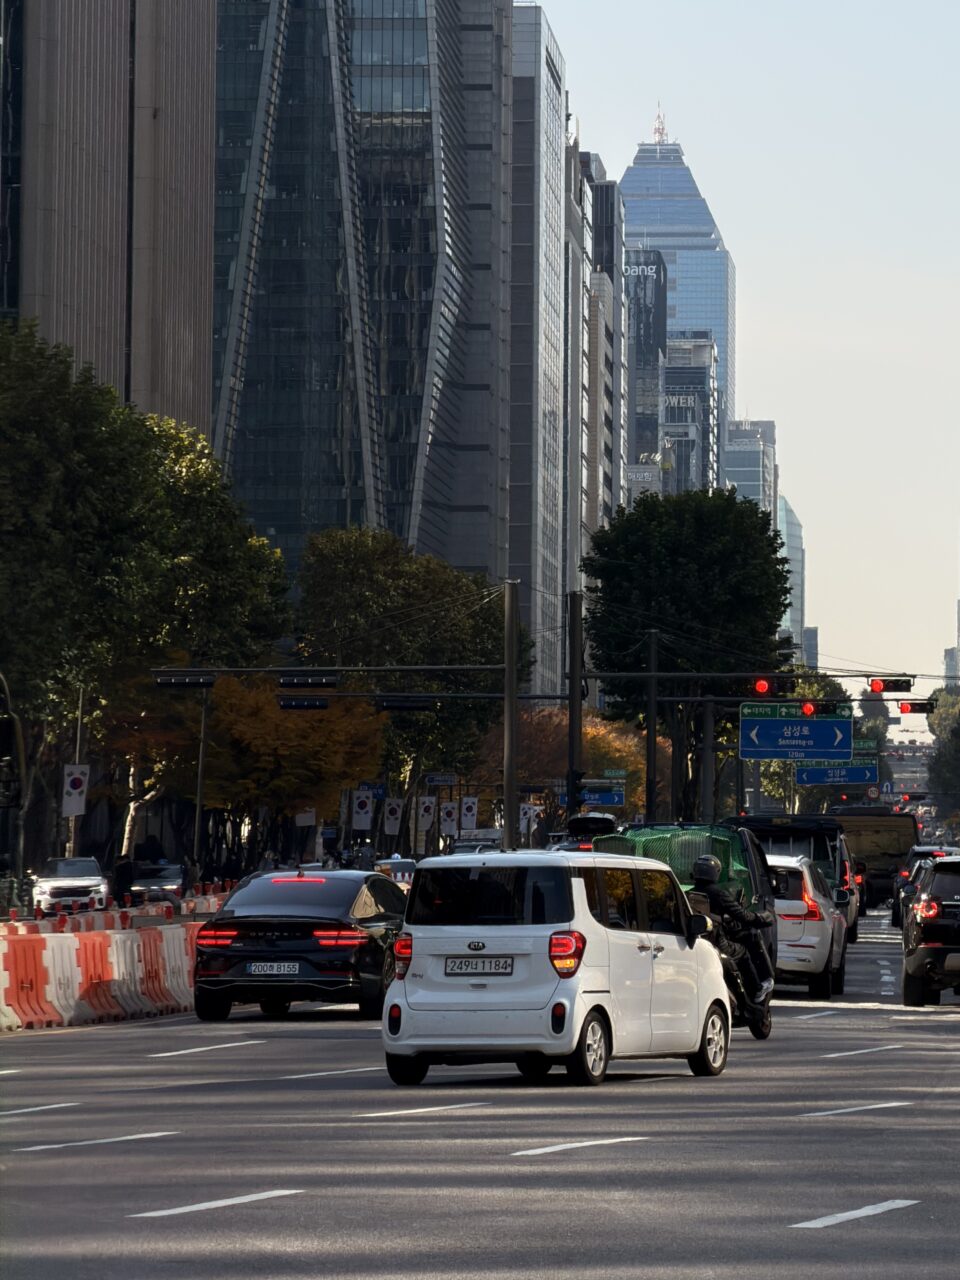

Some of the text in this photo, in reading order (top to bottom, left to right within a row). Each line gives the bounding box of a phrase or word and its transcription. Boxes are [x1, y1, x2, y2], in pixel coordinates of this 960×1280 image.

[783, 725, 811, 737] 삼성로
[469, 942, 483, 950] KIA
[277, 963, 297, 973] 8155
[481, 959, 508, 972] 1184
